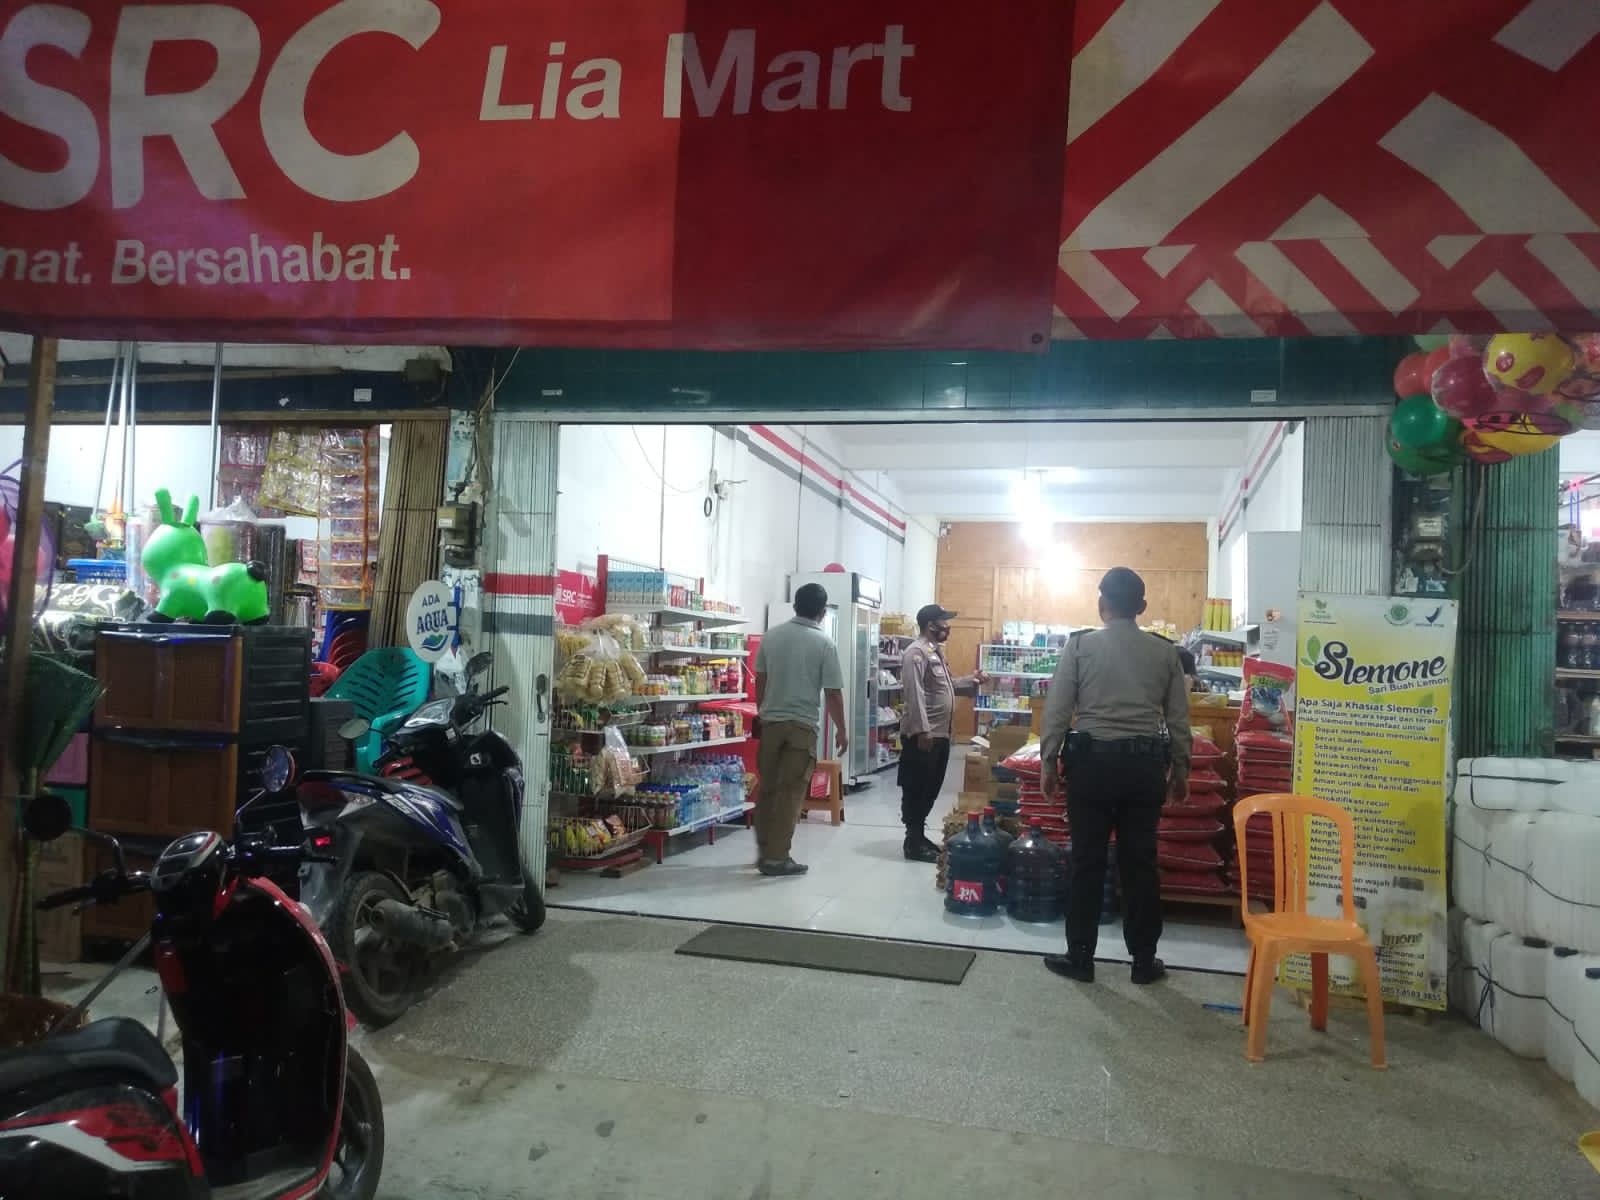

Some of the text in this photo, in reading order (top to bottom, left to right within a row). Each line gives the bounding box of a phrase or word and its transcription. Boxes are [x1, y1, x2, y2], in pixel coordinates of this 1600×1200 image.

[479, 24, 915, 120] Lia Mart
[0, 0, 441, 210] SRC
[111, 231, 411, 285] Bersahabat.
[421, 593, 440, 608] ADA
[562, 589, 577, 603] SRC
[416, 608, 449, 634] AQUA
[1314, 641, 1447, 685] Slemone
[1368, 676, 1449, 695] Sari Buah Lemon
[1299, 697, 1438, 715] Apa Saja Khasiat Slemone?
